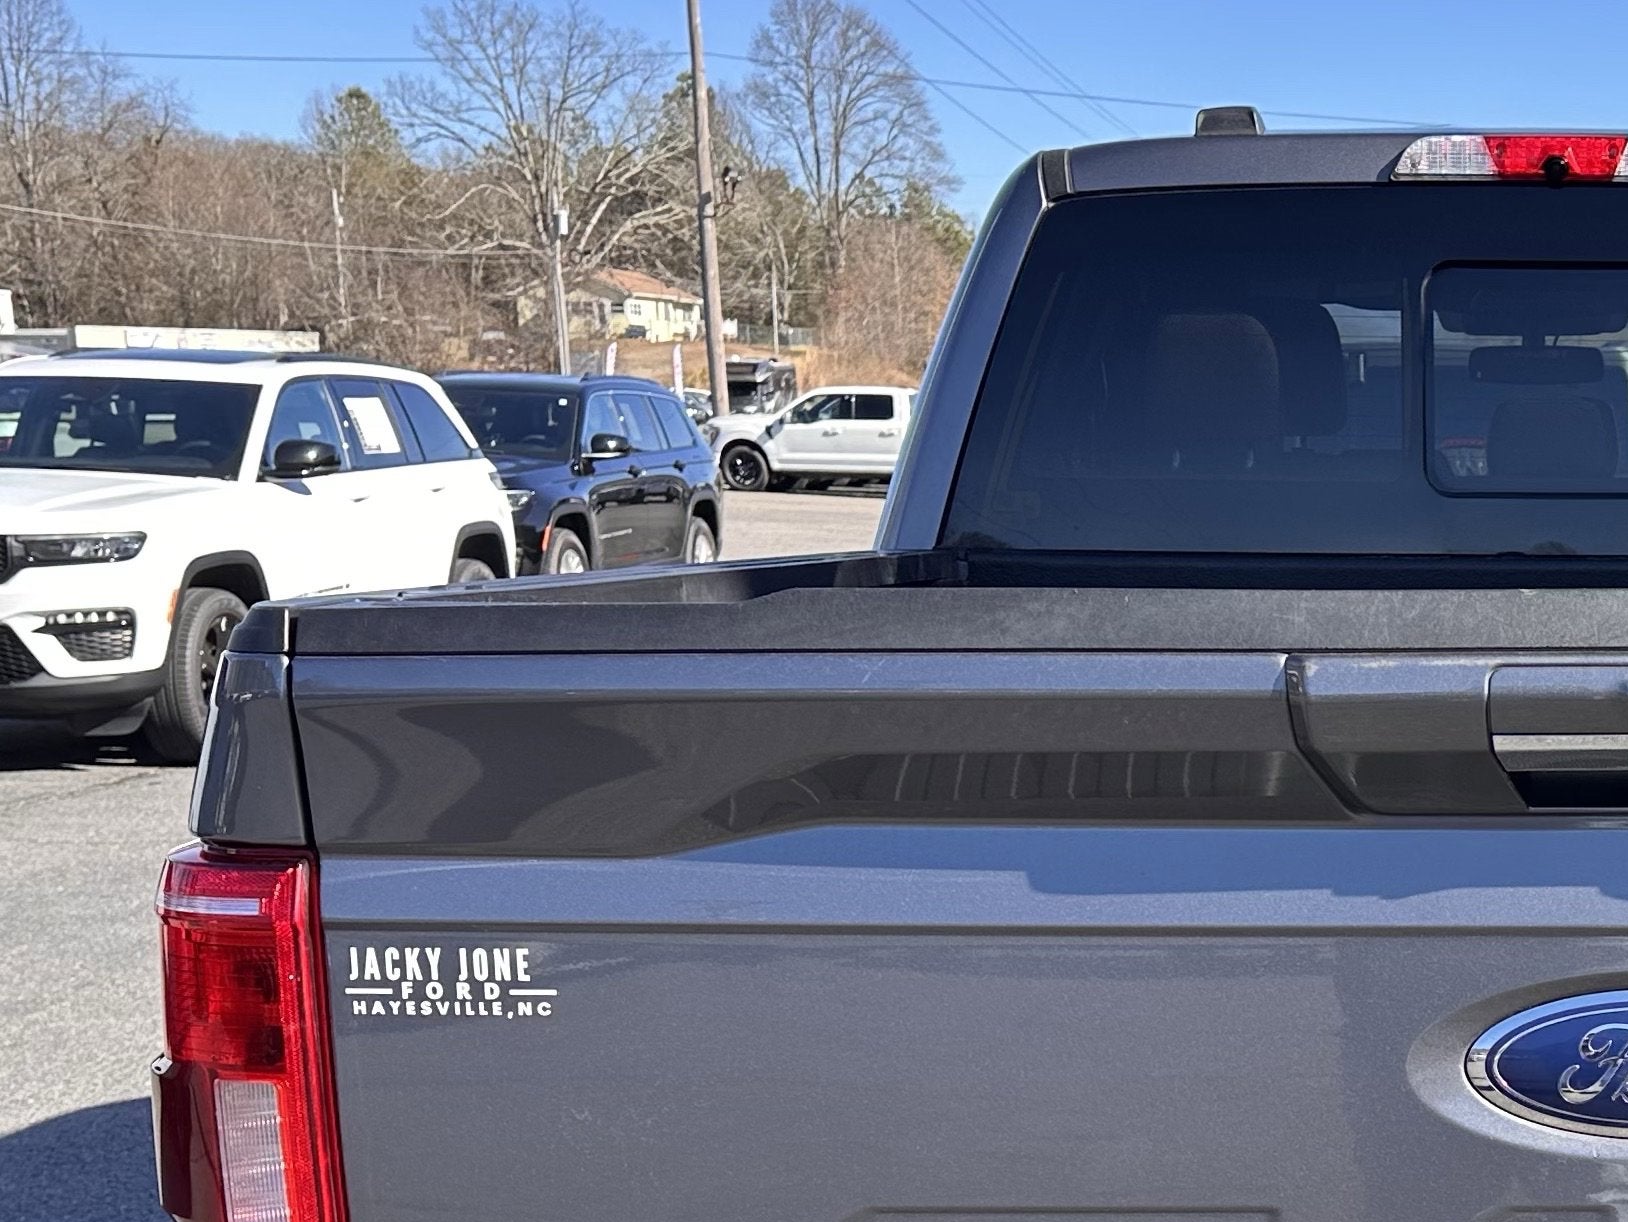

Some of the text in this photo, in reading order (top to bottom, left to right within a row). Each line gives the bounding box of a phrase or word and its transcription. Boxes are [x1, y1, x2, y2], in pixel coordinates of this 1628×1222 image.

[349, 946, 531, 981] JACKY JONE
[401, 981, 501, 1000] FORD
